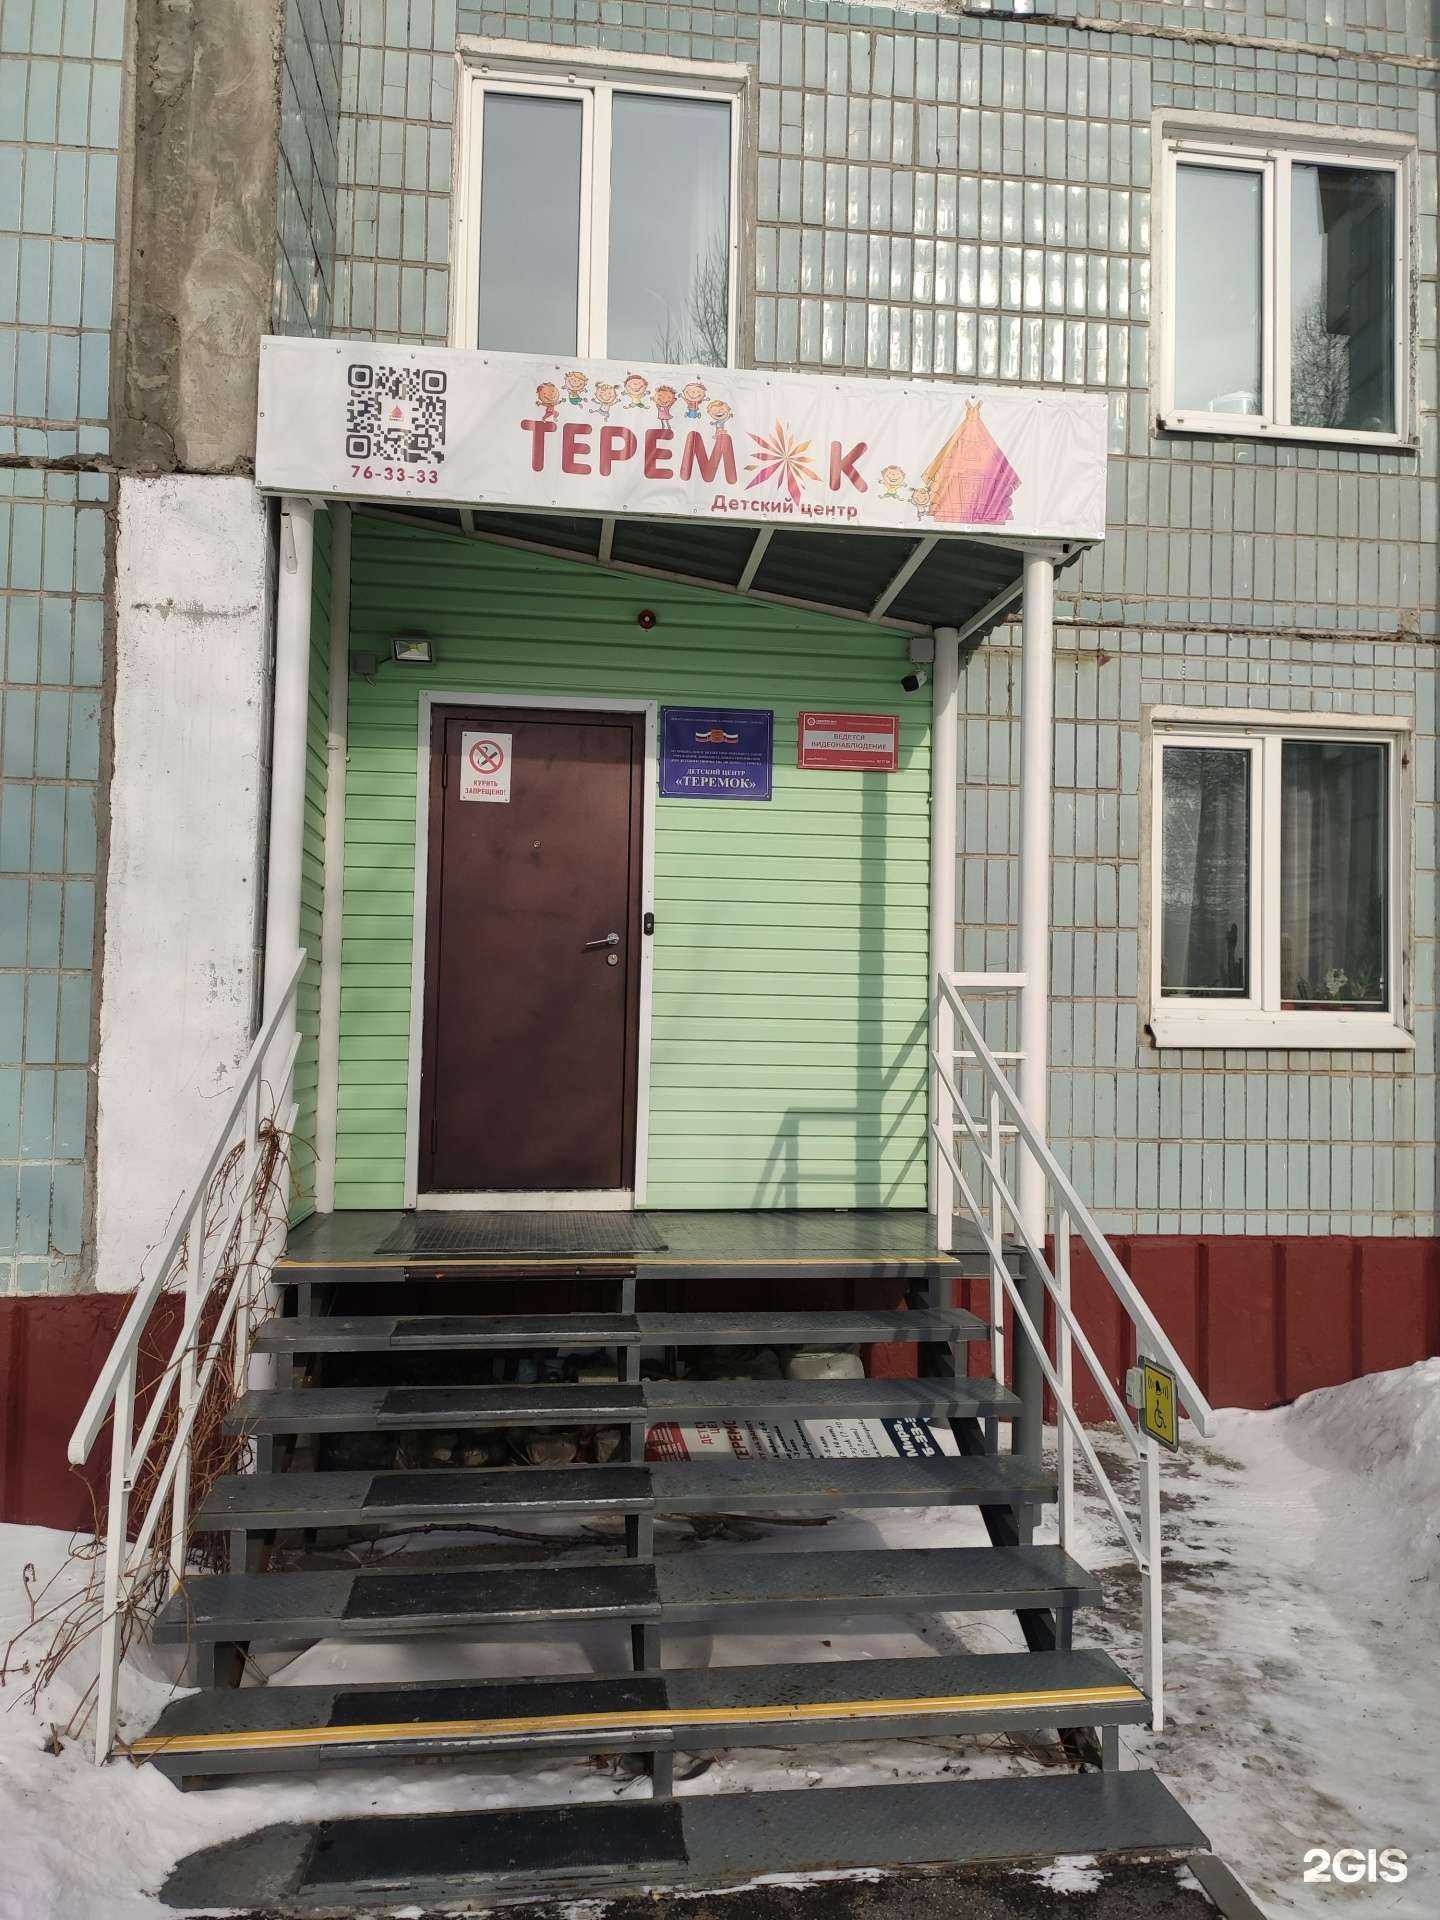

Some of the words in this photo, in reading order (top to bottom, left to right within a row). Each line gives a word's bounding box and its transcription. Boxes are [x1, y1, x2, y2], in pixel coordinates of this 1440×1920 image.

[351, 464, 438, 484] 76-33-33
[710, 494, 796, 514] Детский
[800, 504, 858, 521] центр
[811, 741, 887, 751] ВИДЕОНАБЛЮДЕНИЕ
[687, 767, 721, 776] ДЕТСКИЙ
[721, 769, 746, 777] ЦЕНТР
[675, 775, 757, 789] «ТЕРЕМОК»
[464, 788, 506, 796] ЗАПРЕЩЕНО!
